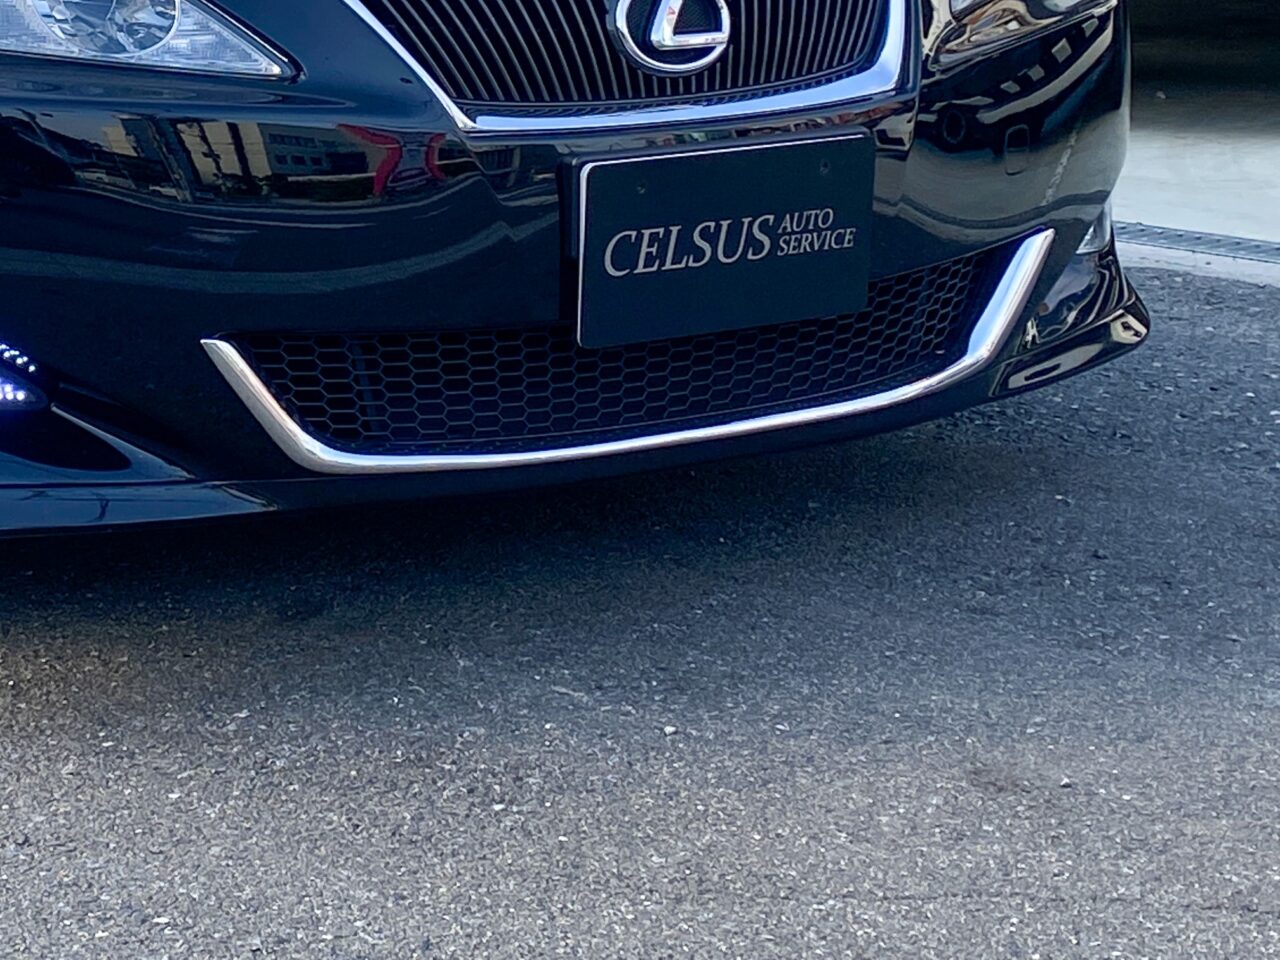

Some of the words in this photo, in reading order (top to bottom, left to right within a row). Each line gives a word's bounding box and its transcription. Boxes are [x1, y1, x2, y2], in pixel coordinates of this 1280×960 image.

[777, 207, 834, 234] AUTO
[603, 214, 774, 278] CELSUS
[777, 227, 857, 257] SERVICE
